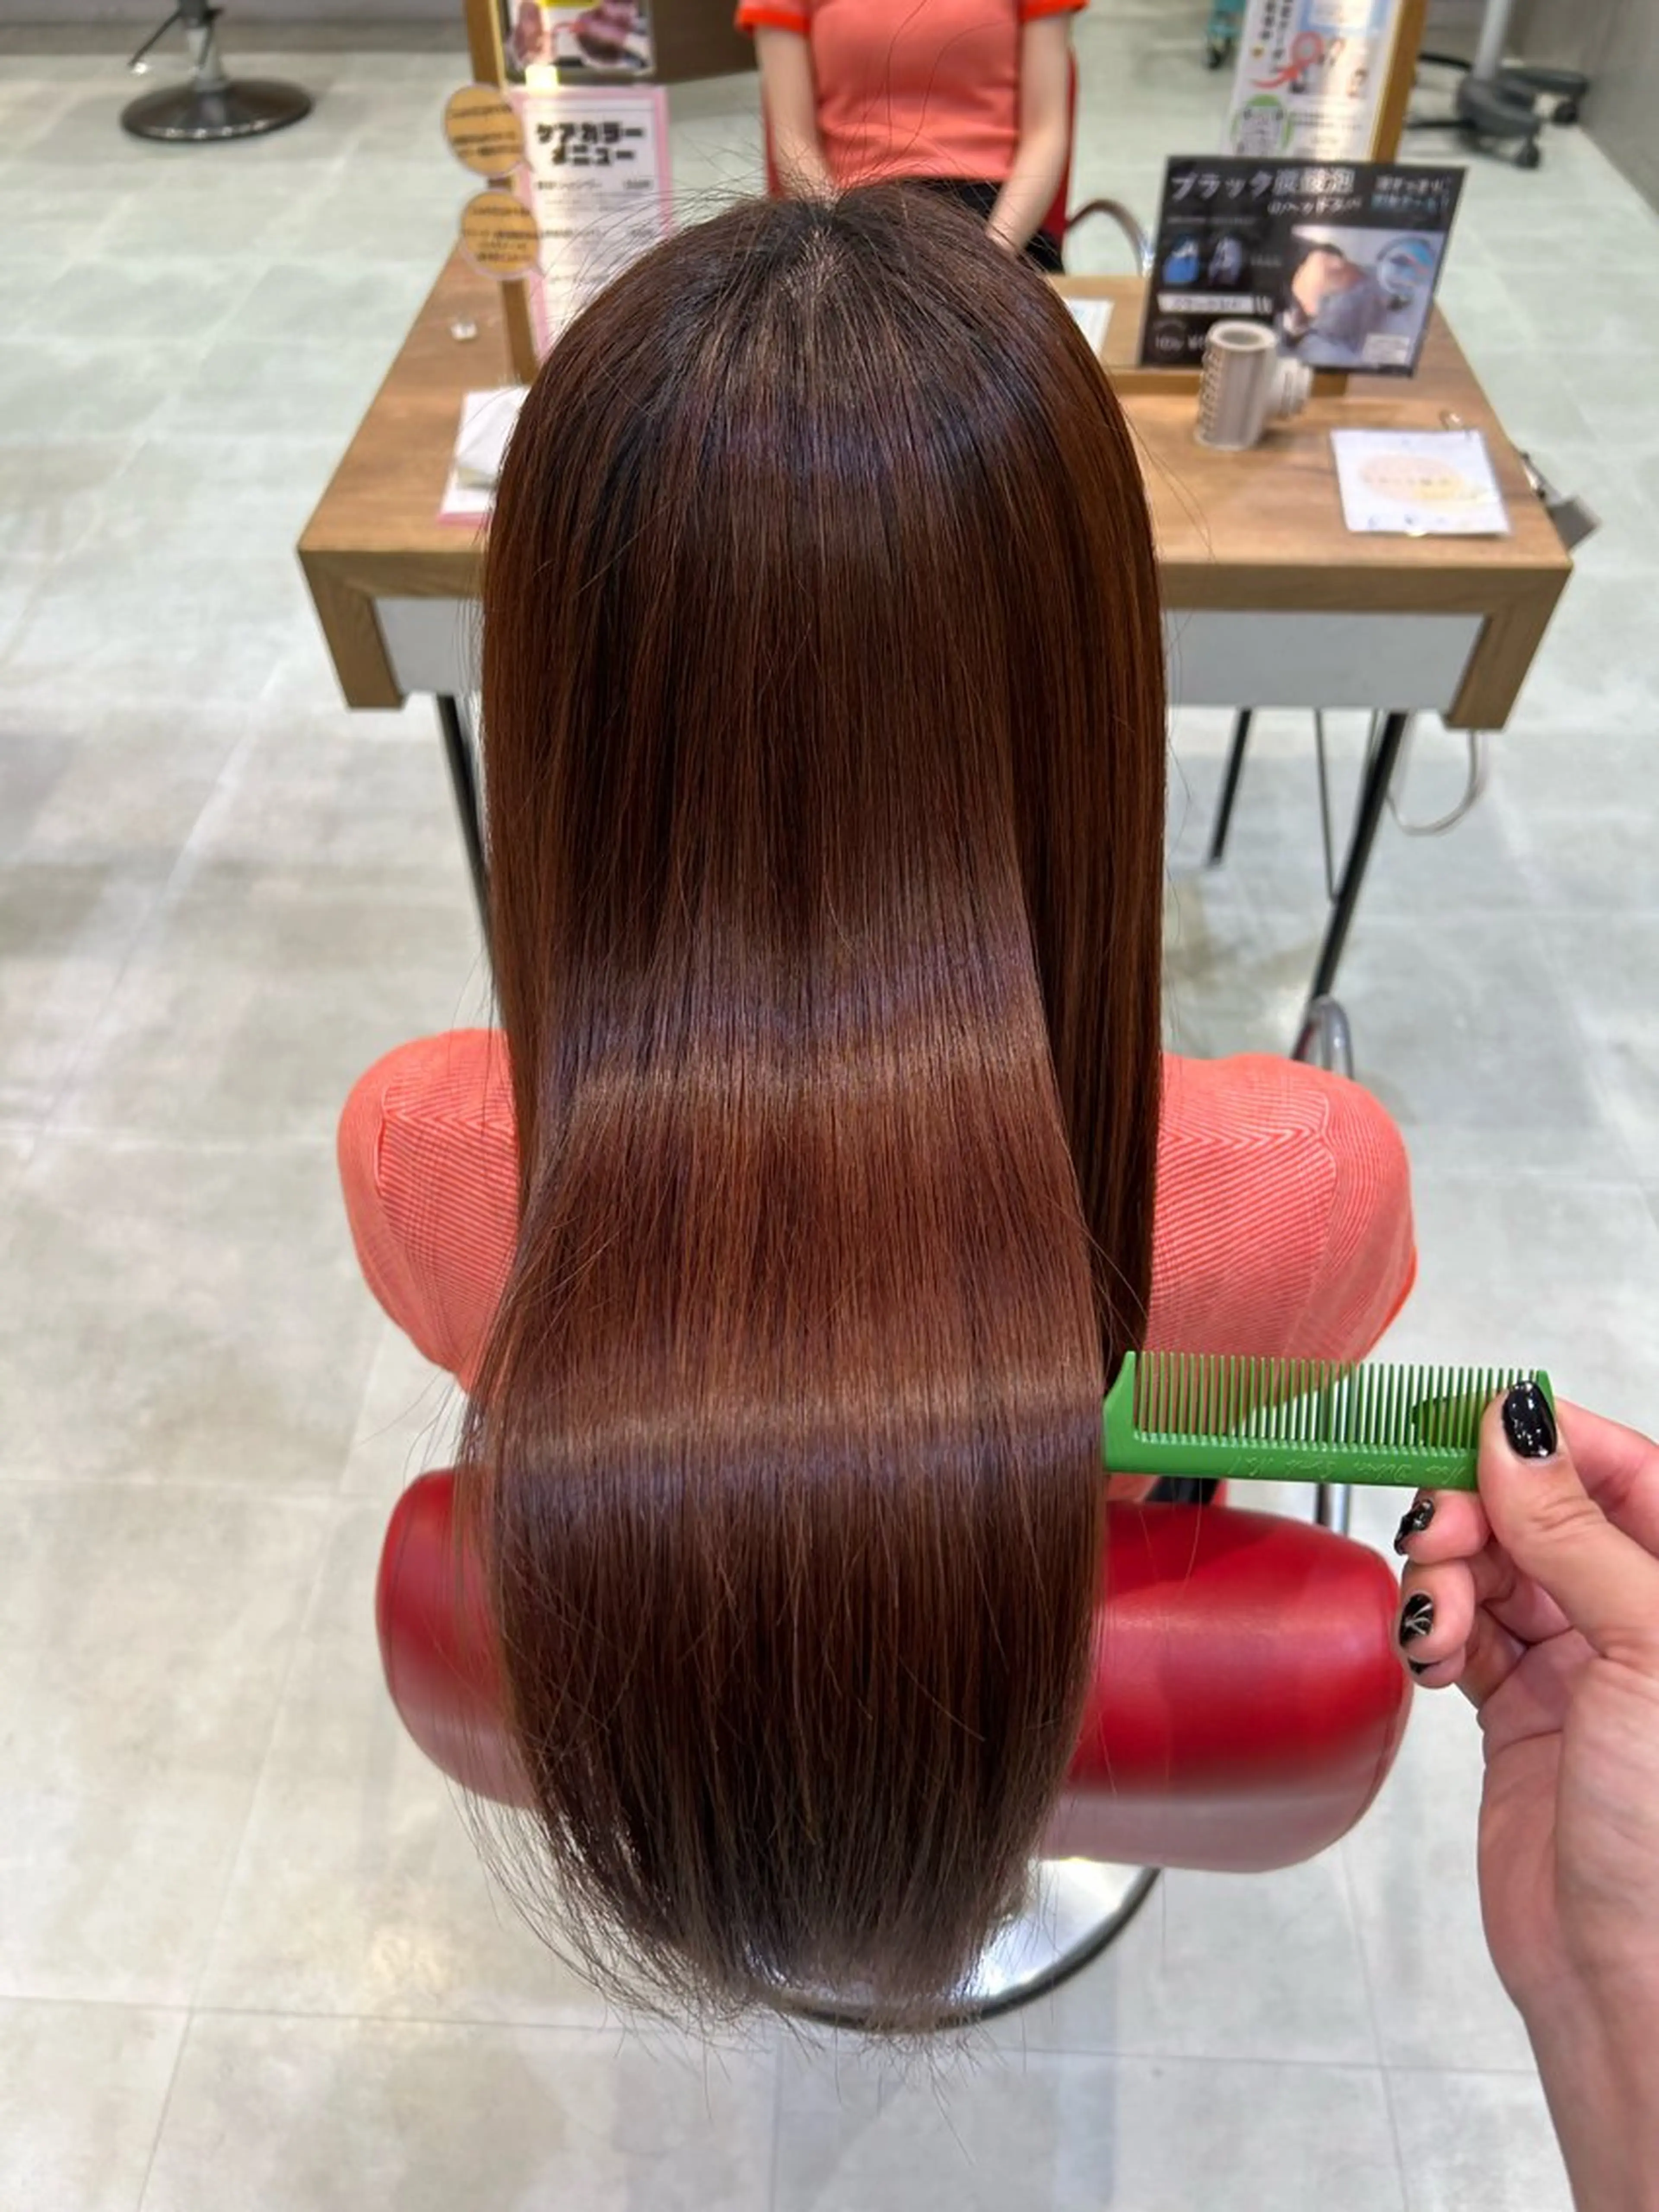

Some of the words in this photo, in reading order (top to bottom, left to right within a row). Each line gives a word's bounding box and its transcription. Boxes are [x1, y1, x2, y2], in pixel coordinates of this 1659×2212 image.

[537, 123, 644, 143] ケアカラー
[552, 145, 635, 166] メニュー
